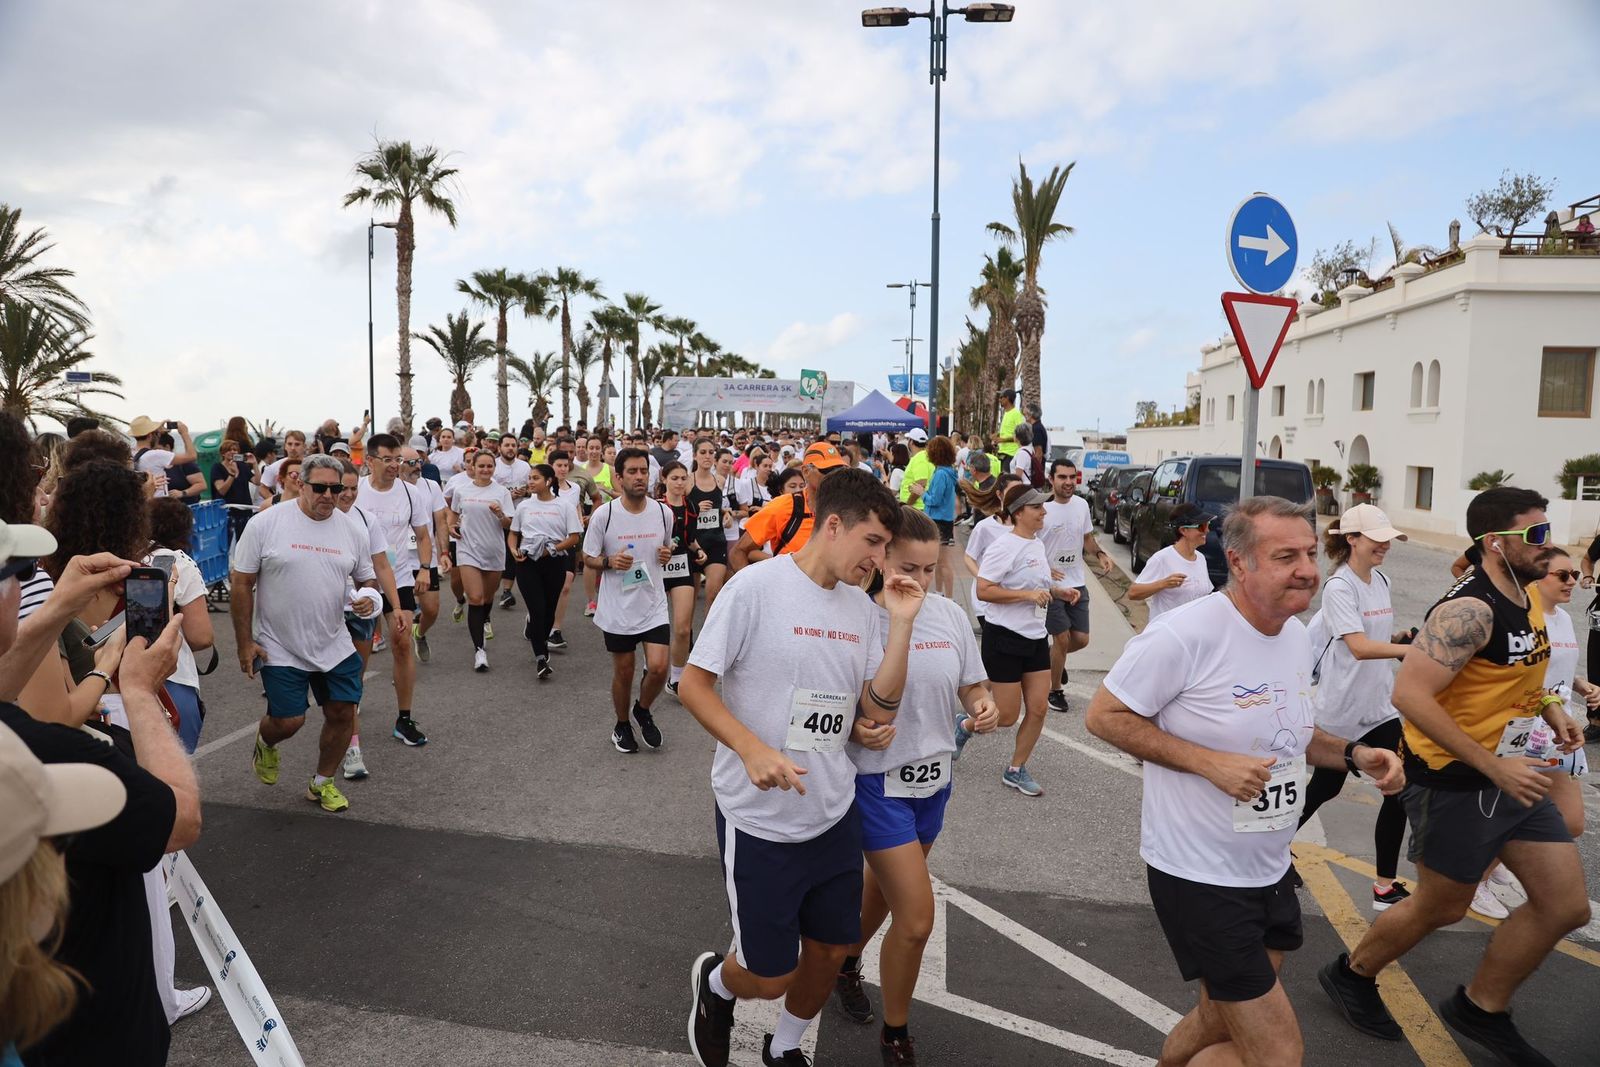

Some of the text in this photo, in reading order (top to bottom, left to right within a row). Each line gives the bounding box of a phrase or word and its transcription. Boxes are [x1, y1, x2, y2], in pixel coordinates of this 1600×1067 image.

[737, 384, 779, 392] CARRERA
[698, 515, 717, 524] 1049
[661, 562, 686, 572] 1084
[634, 569, 643, 580] 8
[793, 626, 803, 636] NO
[828, 630, 837, 640] NO
[803, 711, 844, 735] 408
[899, 761, 942, 784] 625
[1251, 780, 1298, 812] 375
